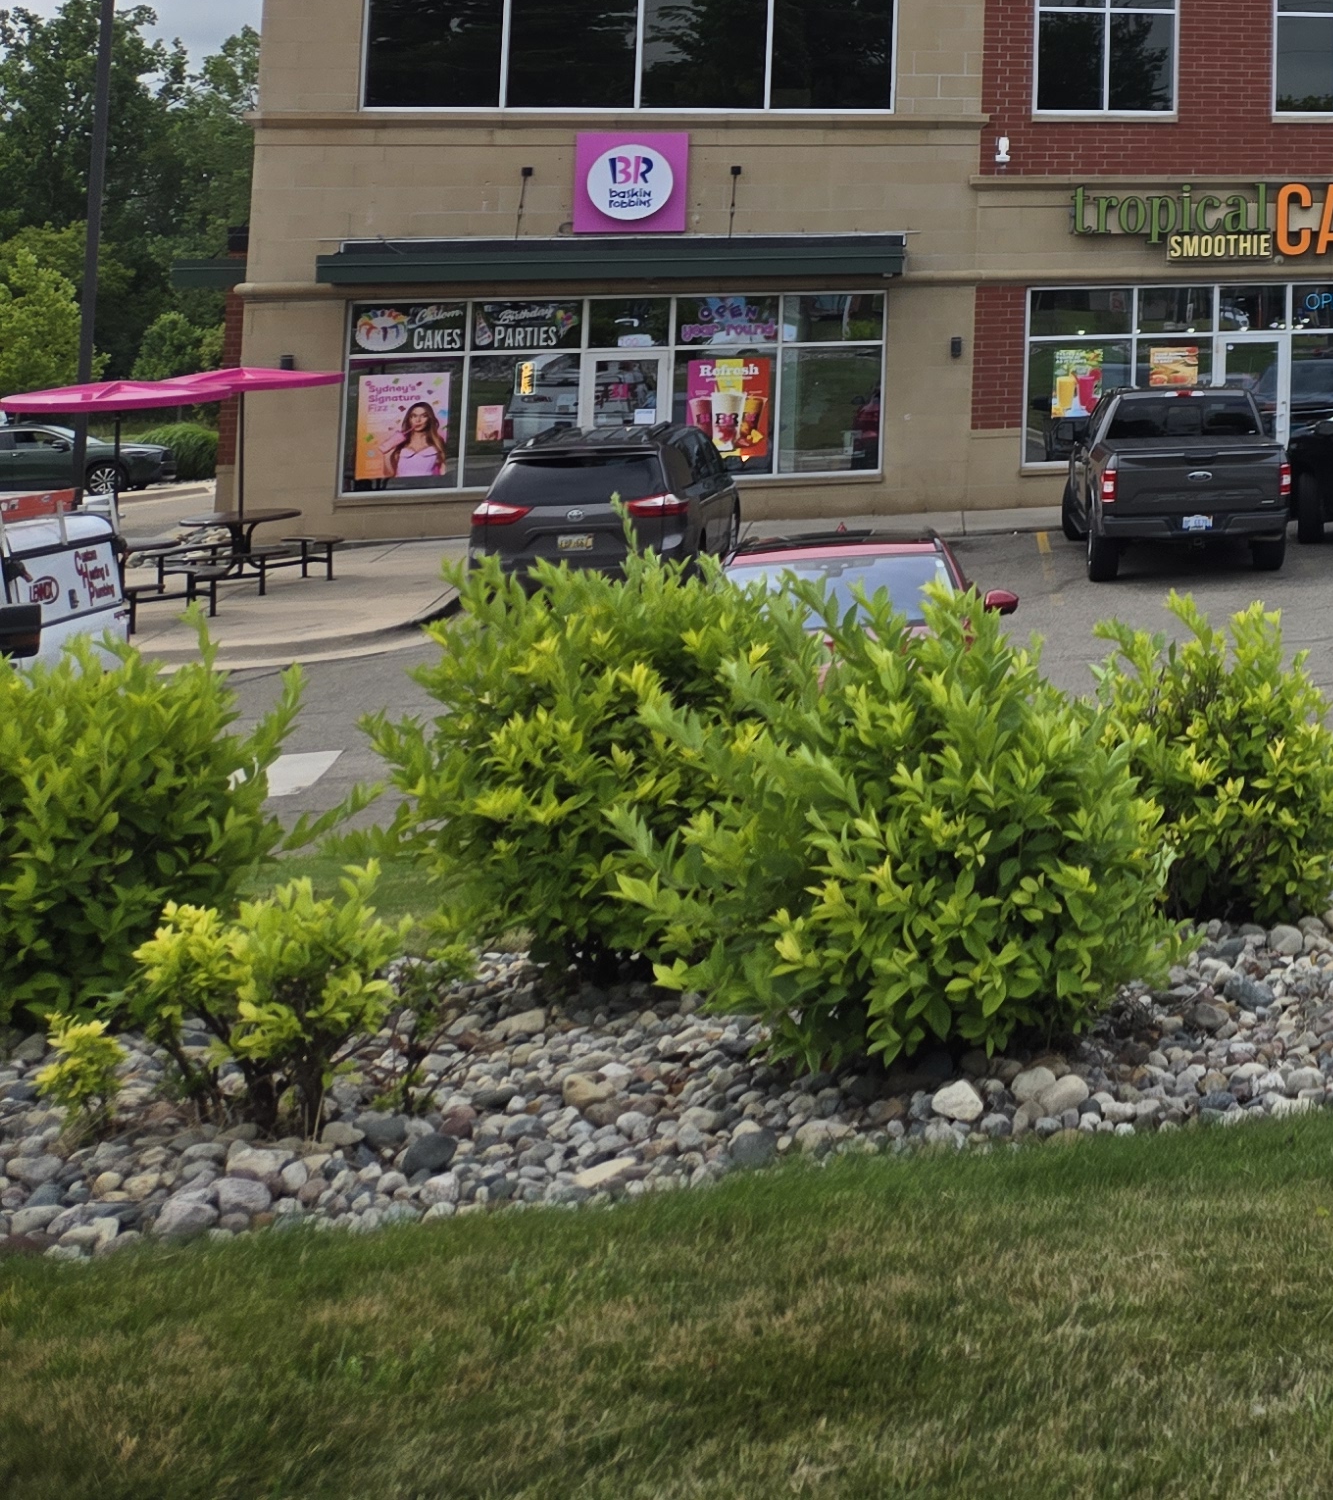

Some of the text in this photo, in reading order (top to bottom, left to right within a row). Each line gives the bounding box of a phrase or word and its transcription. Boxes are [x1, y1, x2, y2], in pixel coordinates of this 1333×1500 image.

[608, 156, 654, 184] BR
[608, 198, 653, 208] robbins
[1071, 182, 1268, 244] tropical
[1169, 234, 1272, 257] SMOOTHIE
[498, 307, 555, 325] Birthday
[698, 304, 759, 322] OPEN
[413, 327, 461, 349] CAKES
[493, 325, 557, 348] PARTIES
[680, 317, 778, 342] year round
[698, 363, 760, 378] Refresh
[368, 393, 422, 404] Signature
[368, 404, 389, 412] Fizz
